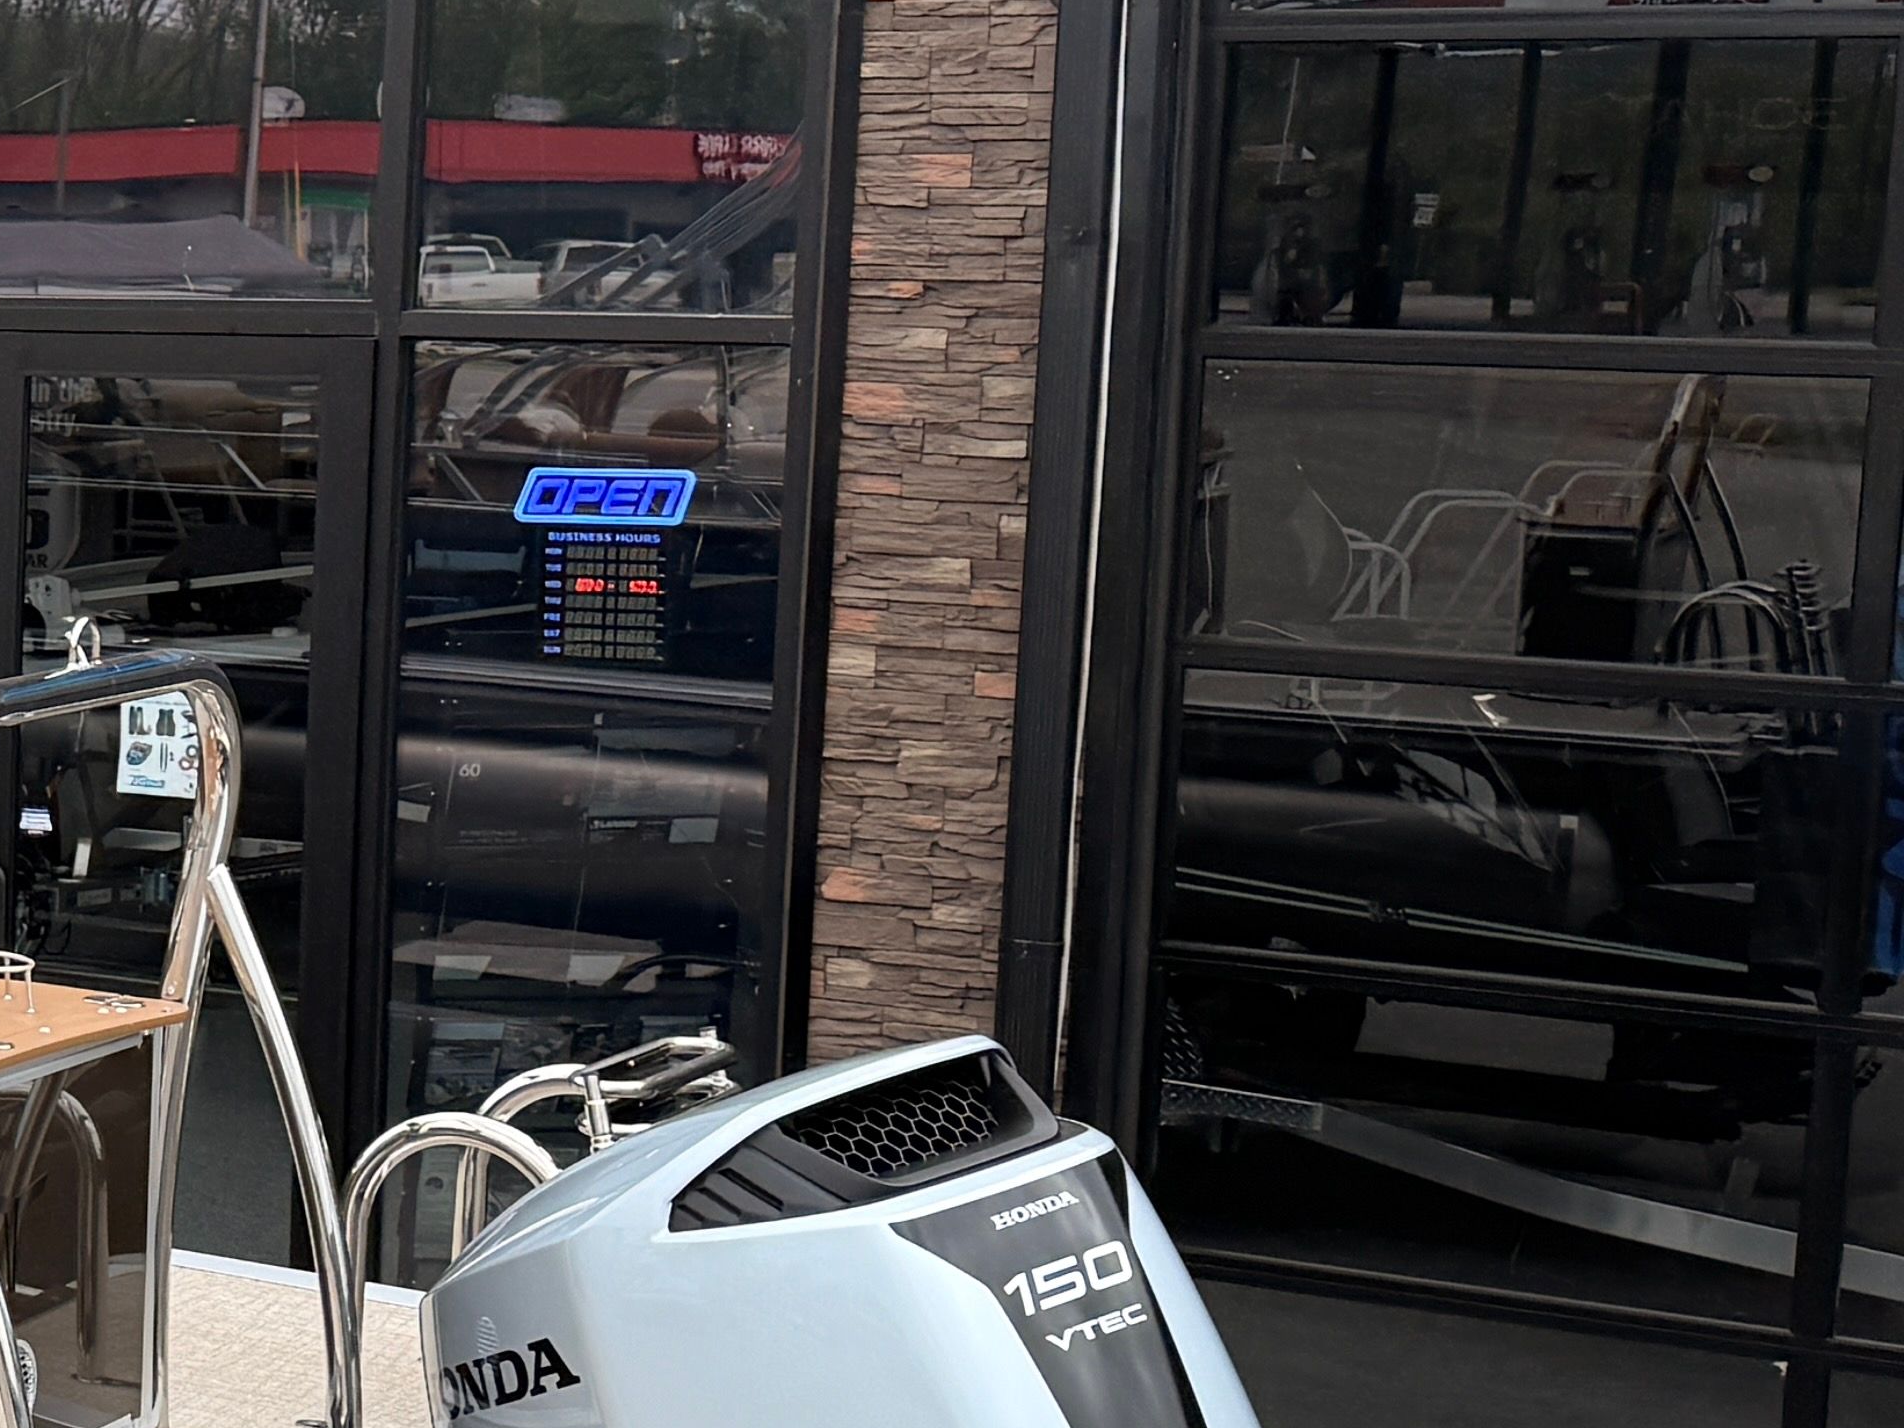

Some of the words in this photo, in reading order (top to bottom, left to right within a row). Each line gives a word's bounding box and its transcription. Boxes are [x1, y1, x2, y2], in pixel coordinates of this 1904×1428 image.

[59, 376, 94, 403] the
[527, 478, 683, 516] OPEN
[548, 531, 612, 543] BUSINESS
[615, 533, 661, 544] HOURS
[458, 762, 481, 778] 60
[990, 1190, 1081, 1231] HONDA
[1003, 1240, 1133, 1317] 150
[1045, 1303, 1148, 1352] VTEC
